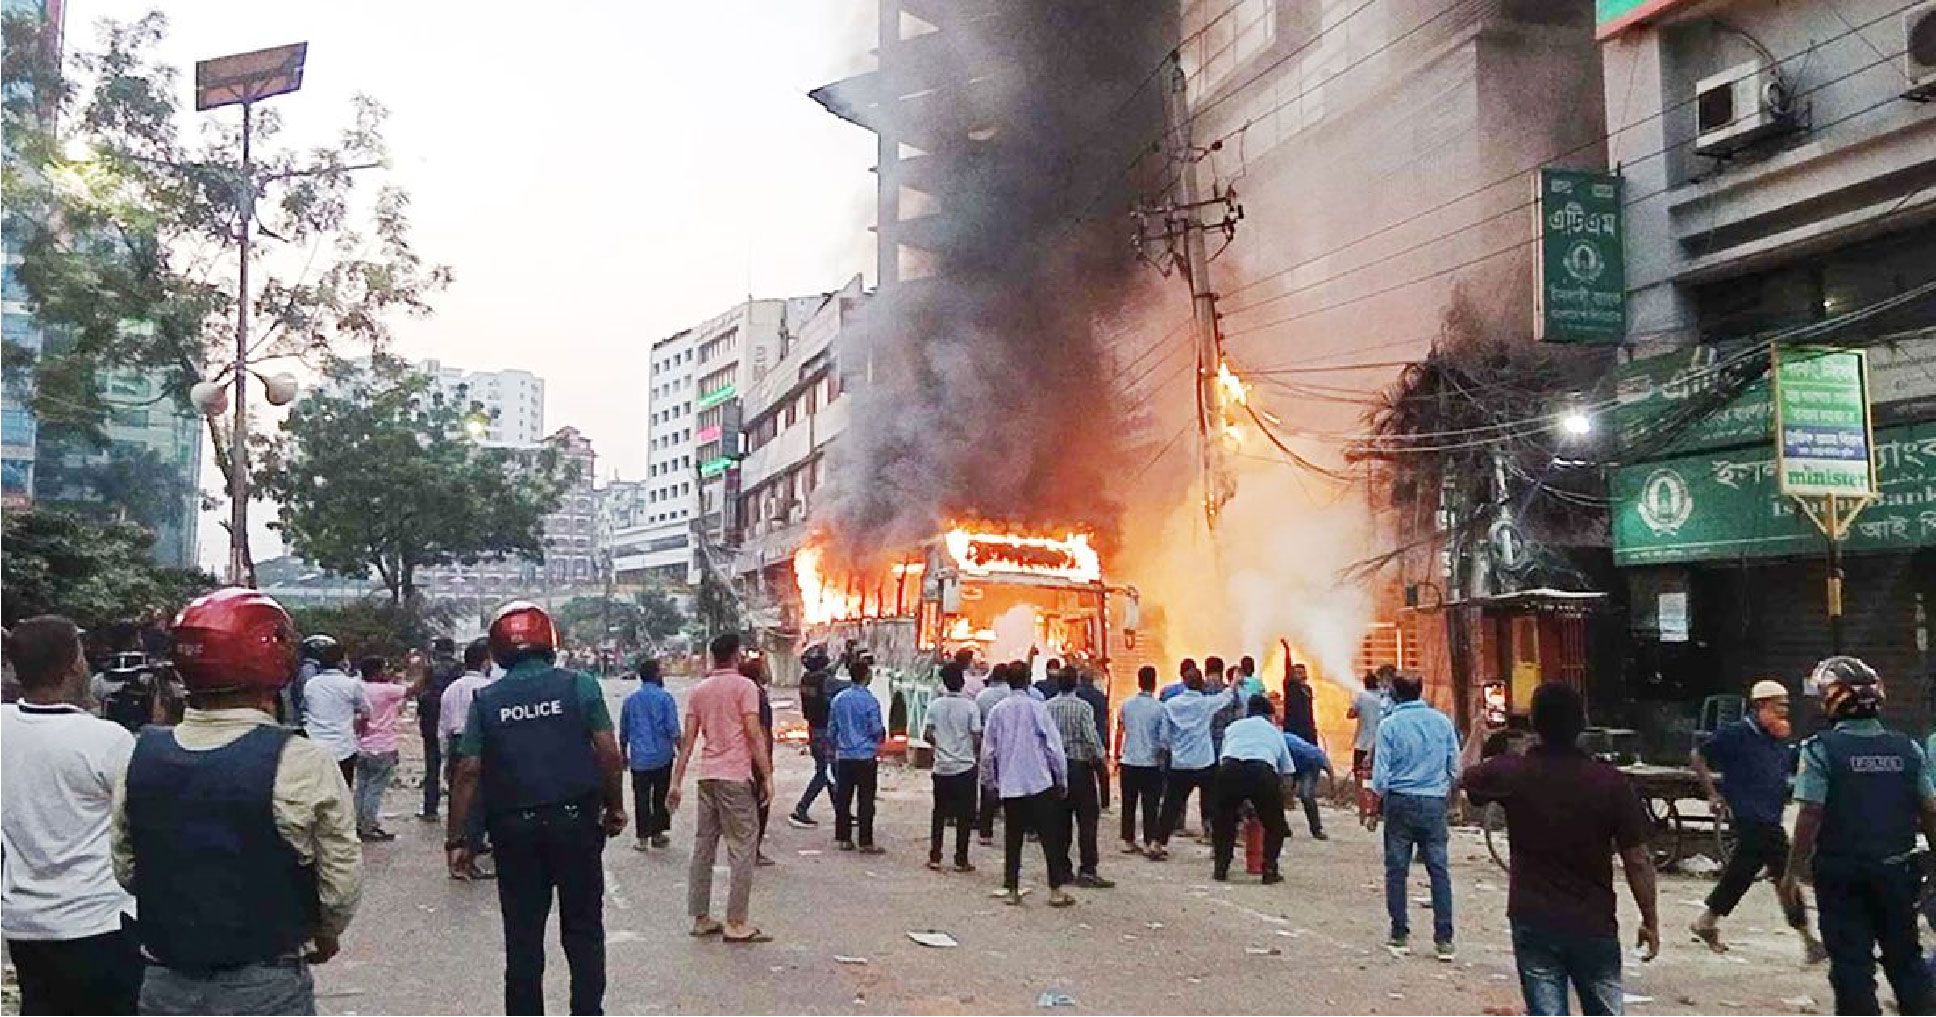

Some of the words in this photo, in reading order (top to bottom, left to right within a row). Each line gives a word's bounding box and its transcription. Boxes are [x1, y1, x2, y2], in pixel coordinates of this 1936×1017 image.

[1549, 201, 1616, 236] এটিএম
[1788, 467, 1867, 487] minister
[500, 700, 563, 722] POLICE
